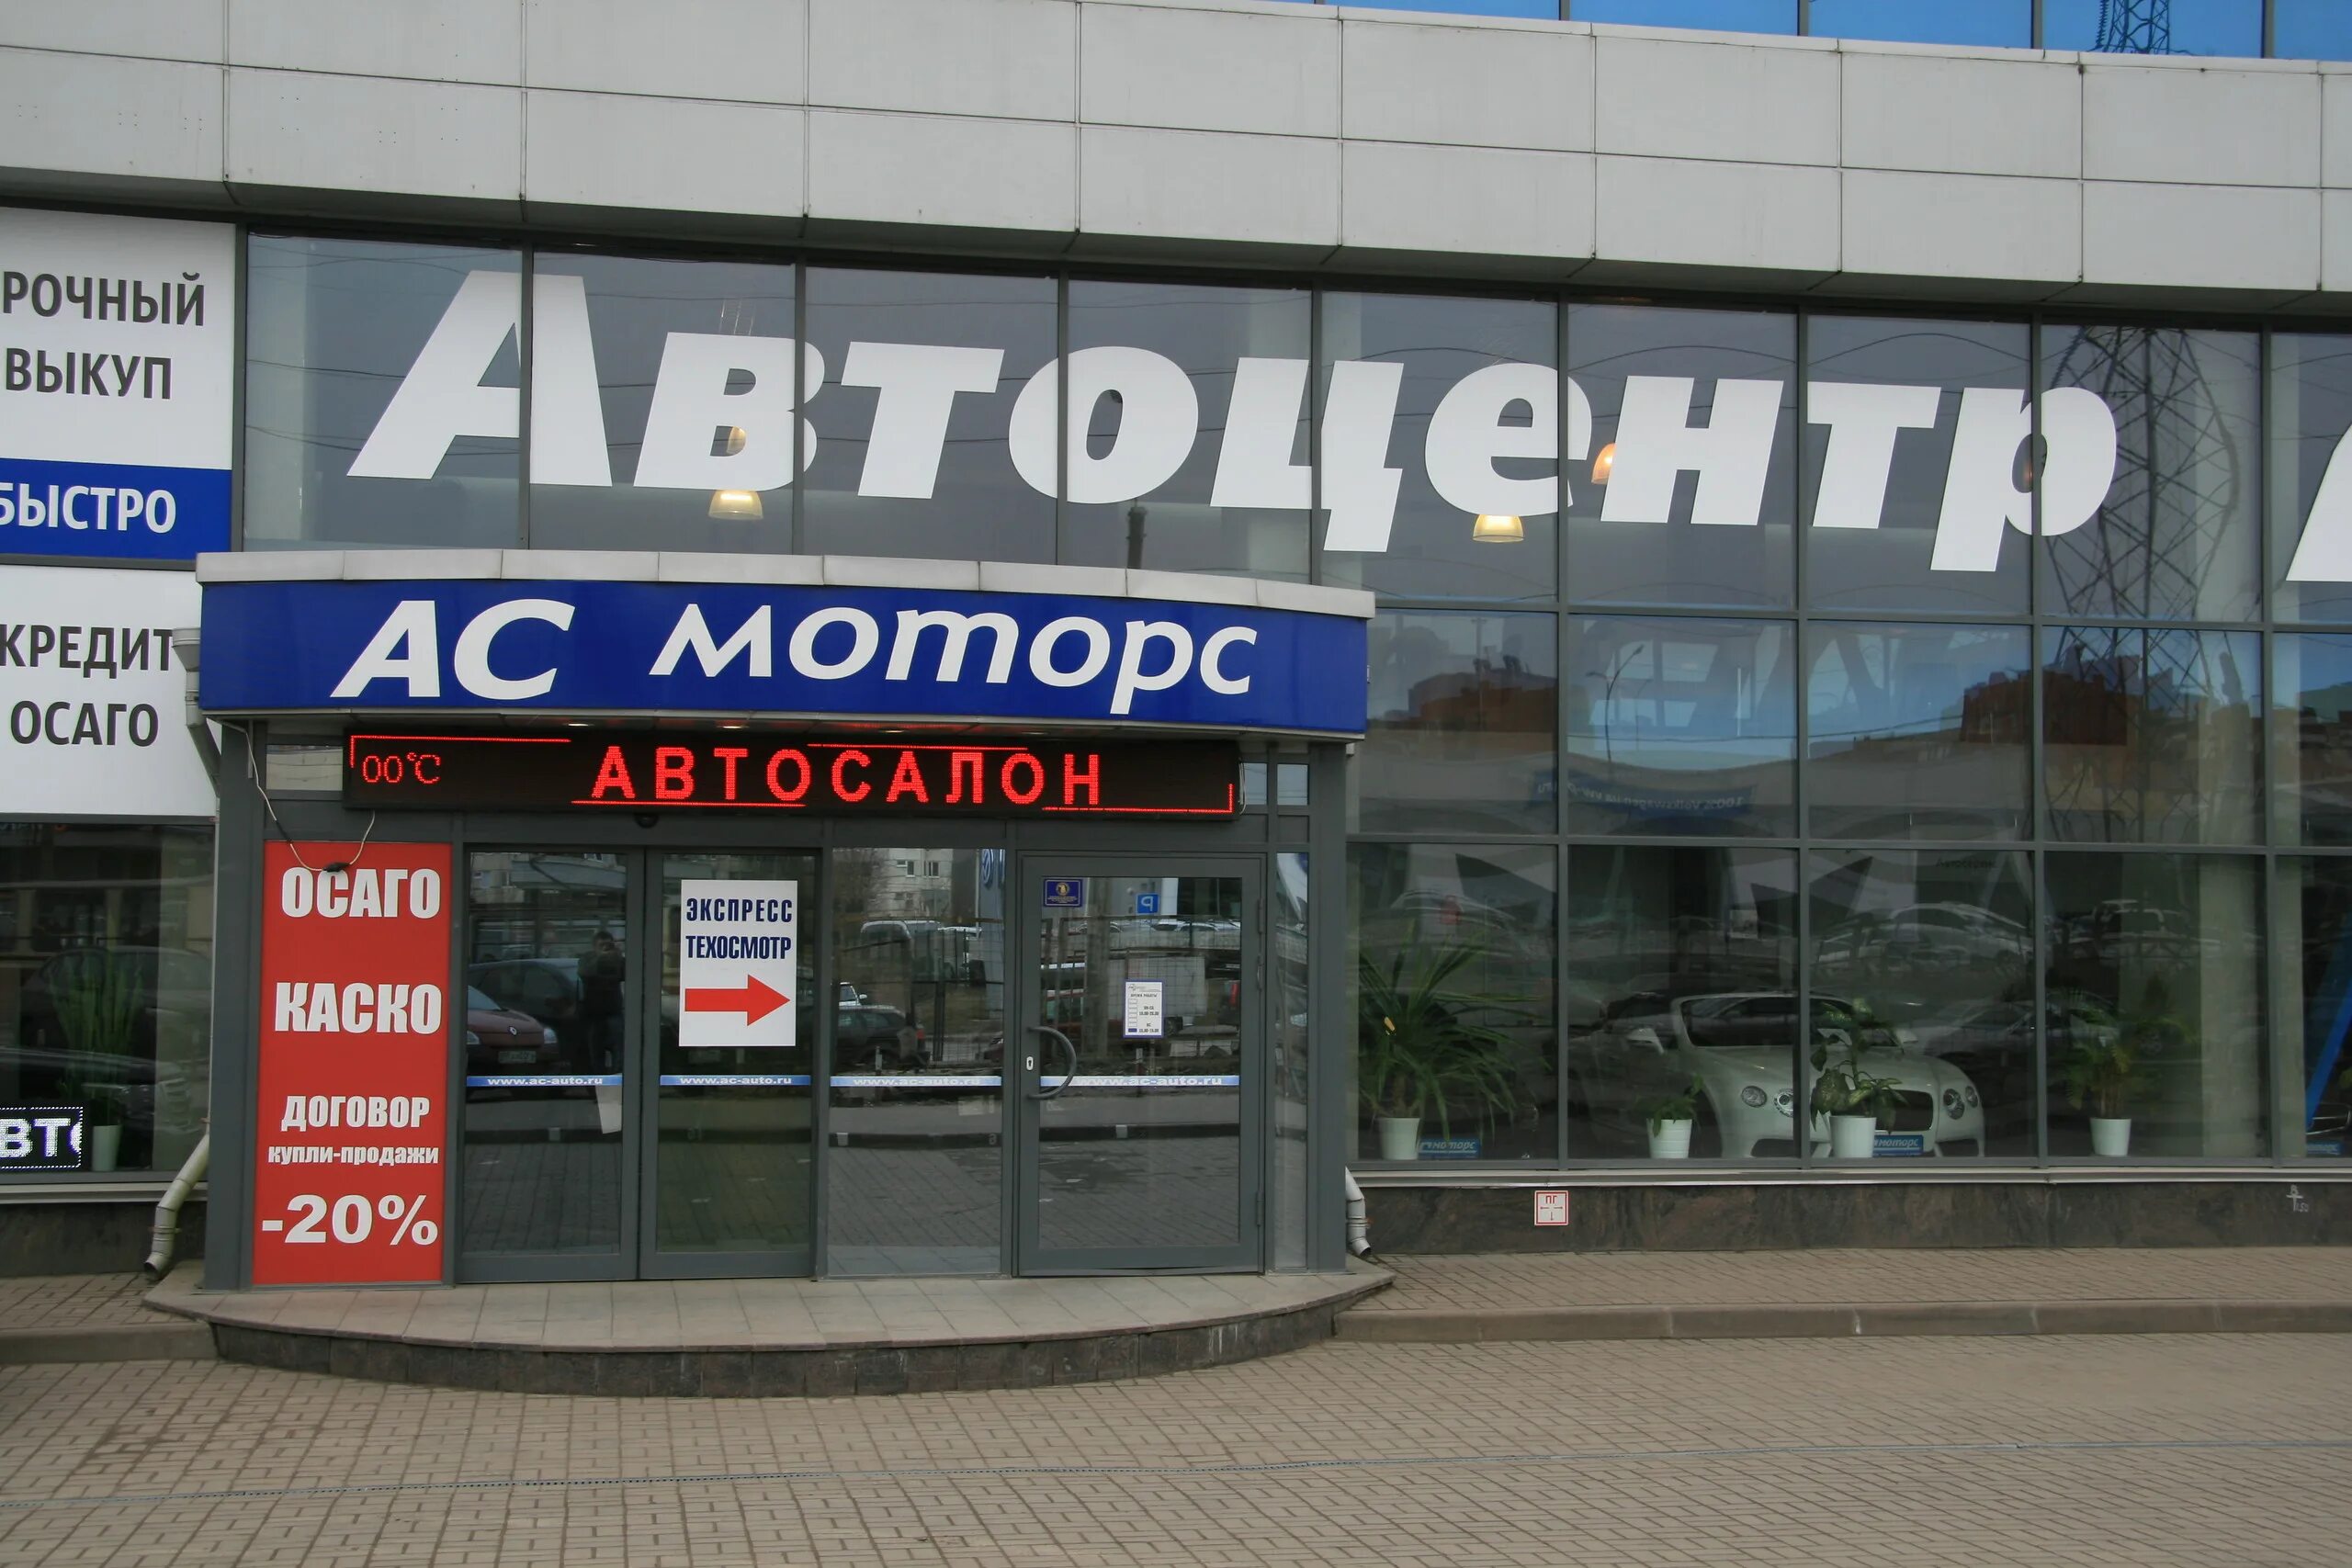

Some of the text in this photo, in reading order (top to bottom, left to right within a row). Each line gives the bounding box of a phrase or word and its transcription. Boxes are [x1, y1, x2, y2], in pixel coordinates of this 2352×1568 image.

[2, 271, 207, 327] РОЧНЫЙ
[6, 347, 174, 400] ВЫКУП
[346, 269, 2119, 573] Автоцентр
[0, 481, 177, 535] БЫСТРО
[0, 624, 174, 680] КРЕДИТ
[330, 598, 1259, 716] АС моторс
[10, 700, 160, 747] ОСАГО
[592, 745, 1100, 806] АВТОСАЛОН
[281, 866, 442, 919] ОСАГО
[685, 897, 793, 923] ЭКСПРЕСС
[685, 934, 792, 960] ТЕХОСМОТР
[275, 981, 443, 1034] КАСКО
[487, 1077, 604, 1086] www.ac-auto.ru
[680, 1077, 792, 1085] www.ac-auto.ru
[853, 1077, 981, 1086] www.ac-auto.ru
[280, 1095, 431, 1133] ДОГОВОР
[267, 1145, 439, 1166] купли-продажи
[262, 1193, 439, 1247] -20%
[1545, 1195, 1557, 1204] ПГ
